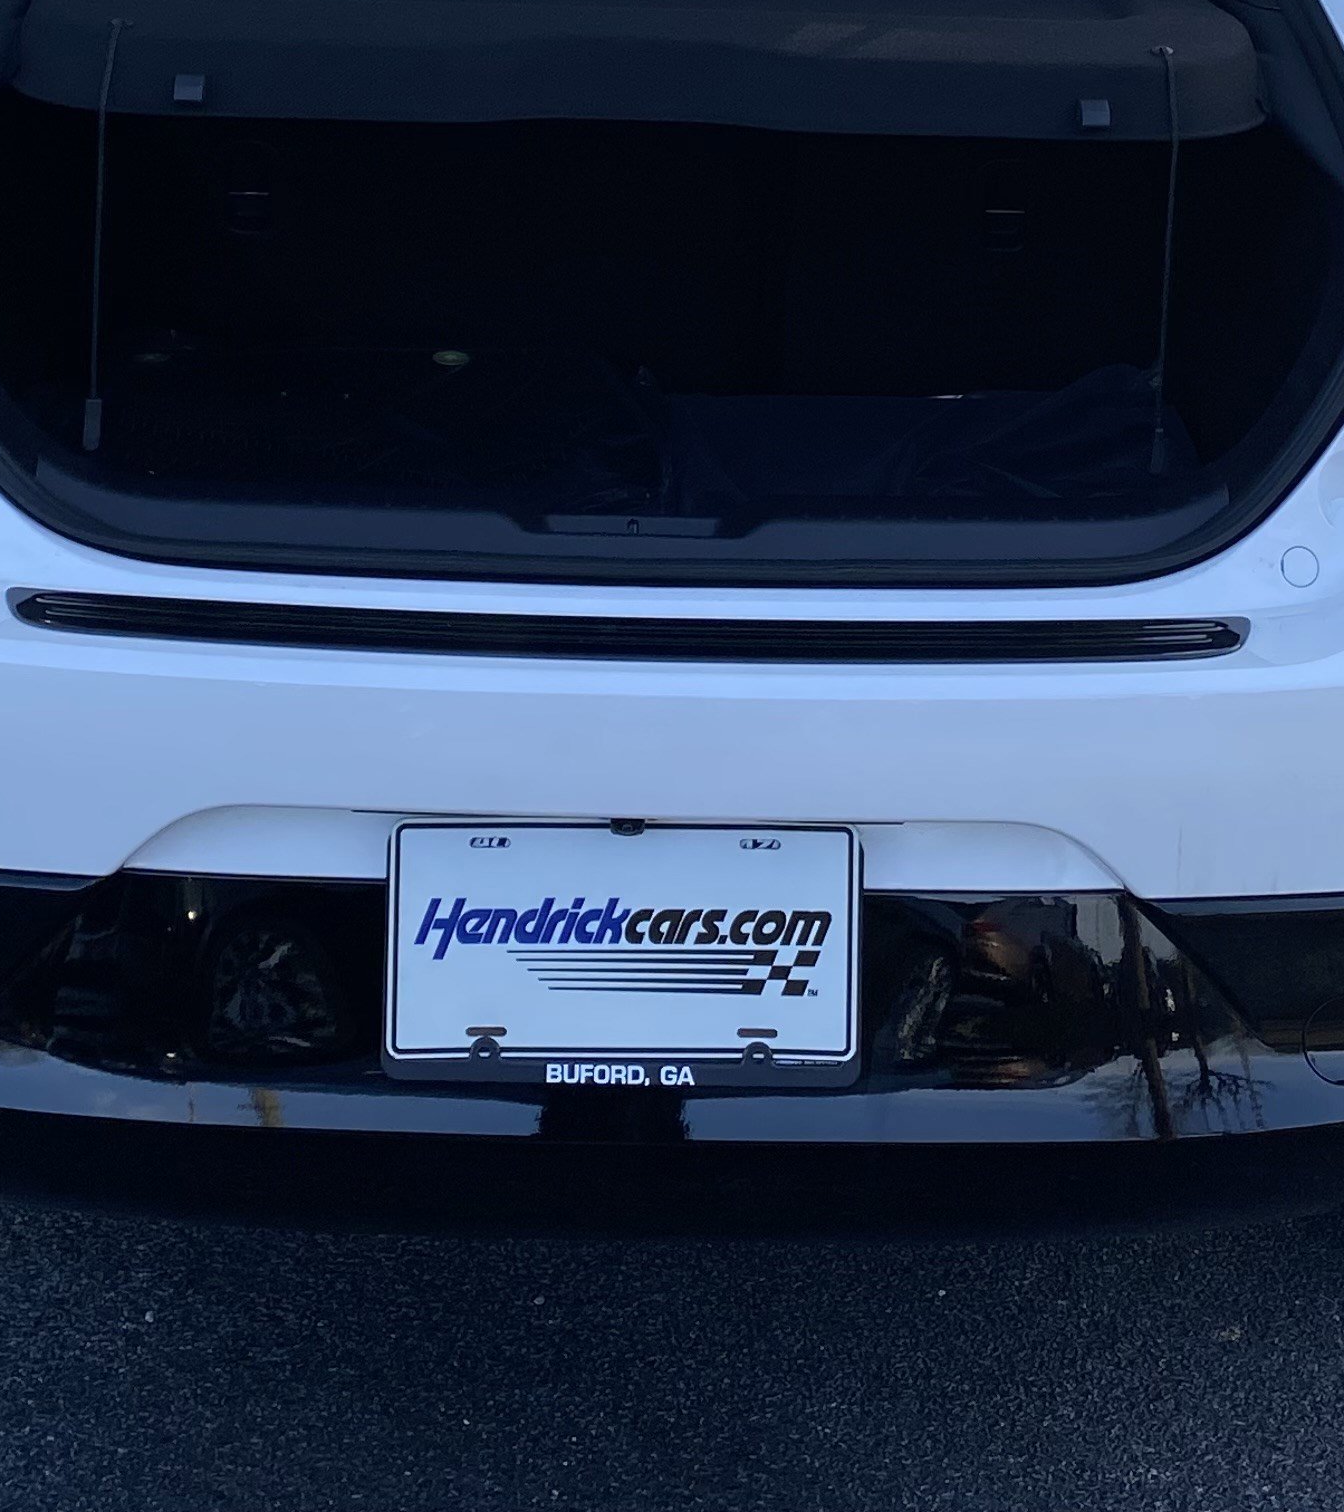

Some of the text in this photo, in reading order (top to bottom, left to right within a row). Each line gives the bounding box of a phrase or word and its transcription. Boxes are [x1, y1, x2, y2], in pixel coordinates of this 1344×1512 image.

[413, 897, 833, 961] Hendrickcars.com
[545, 1063, 696, 1087] BUFORD, GA
